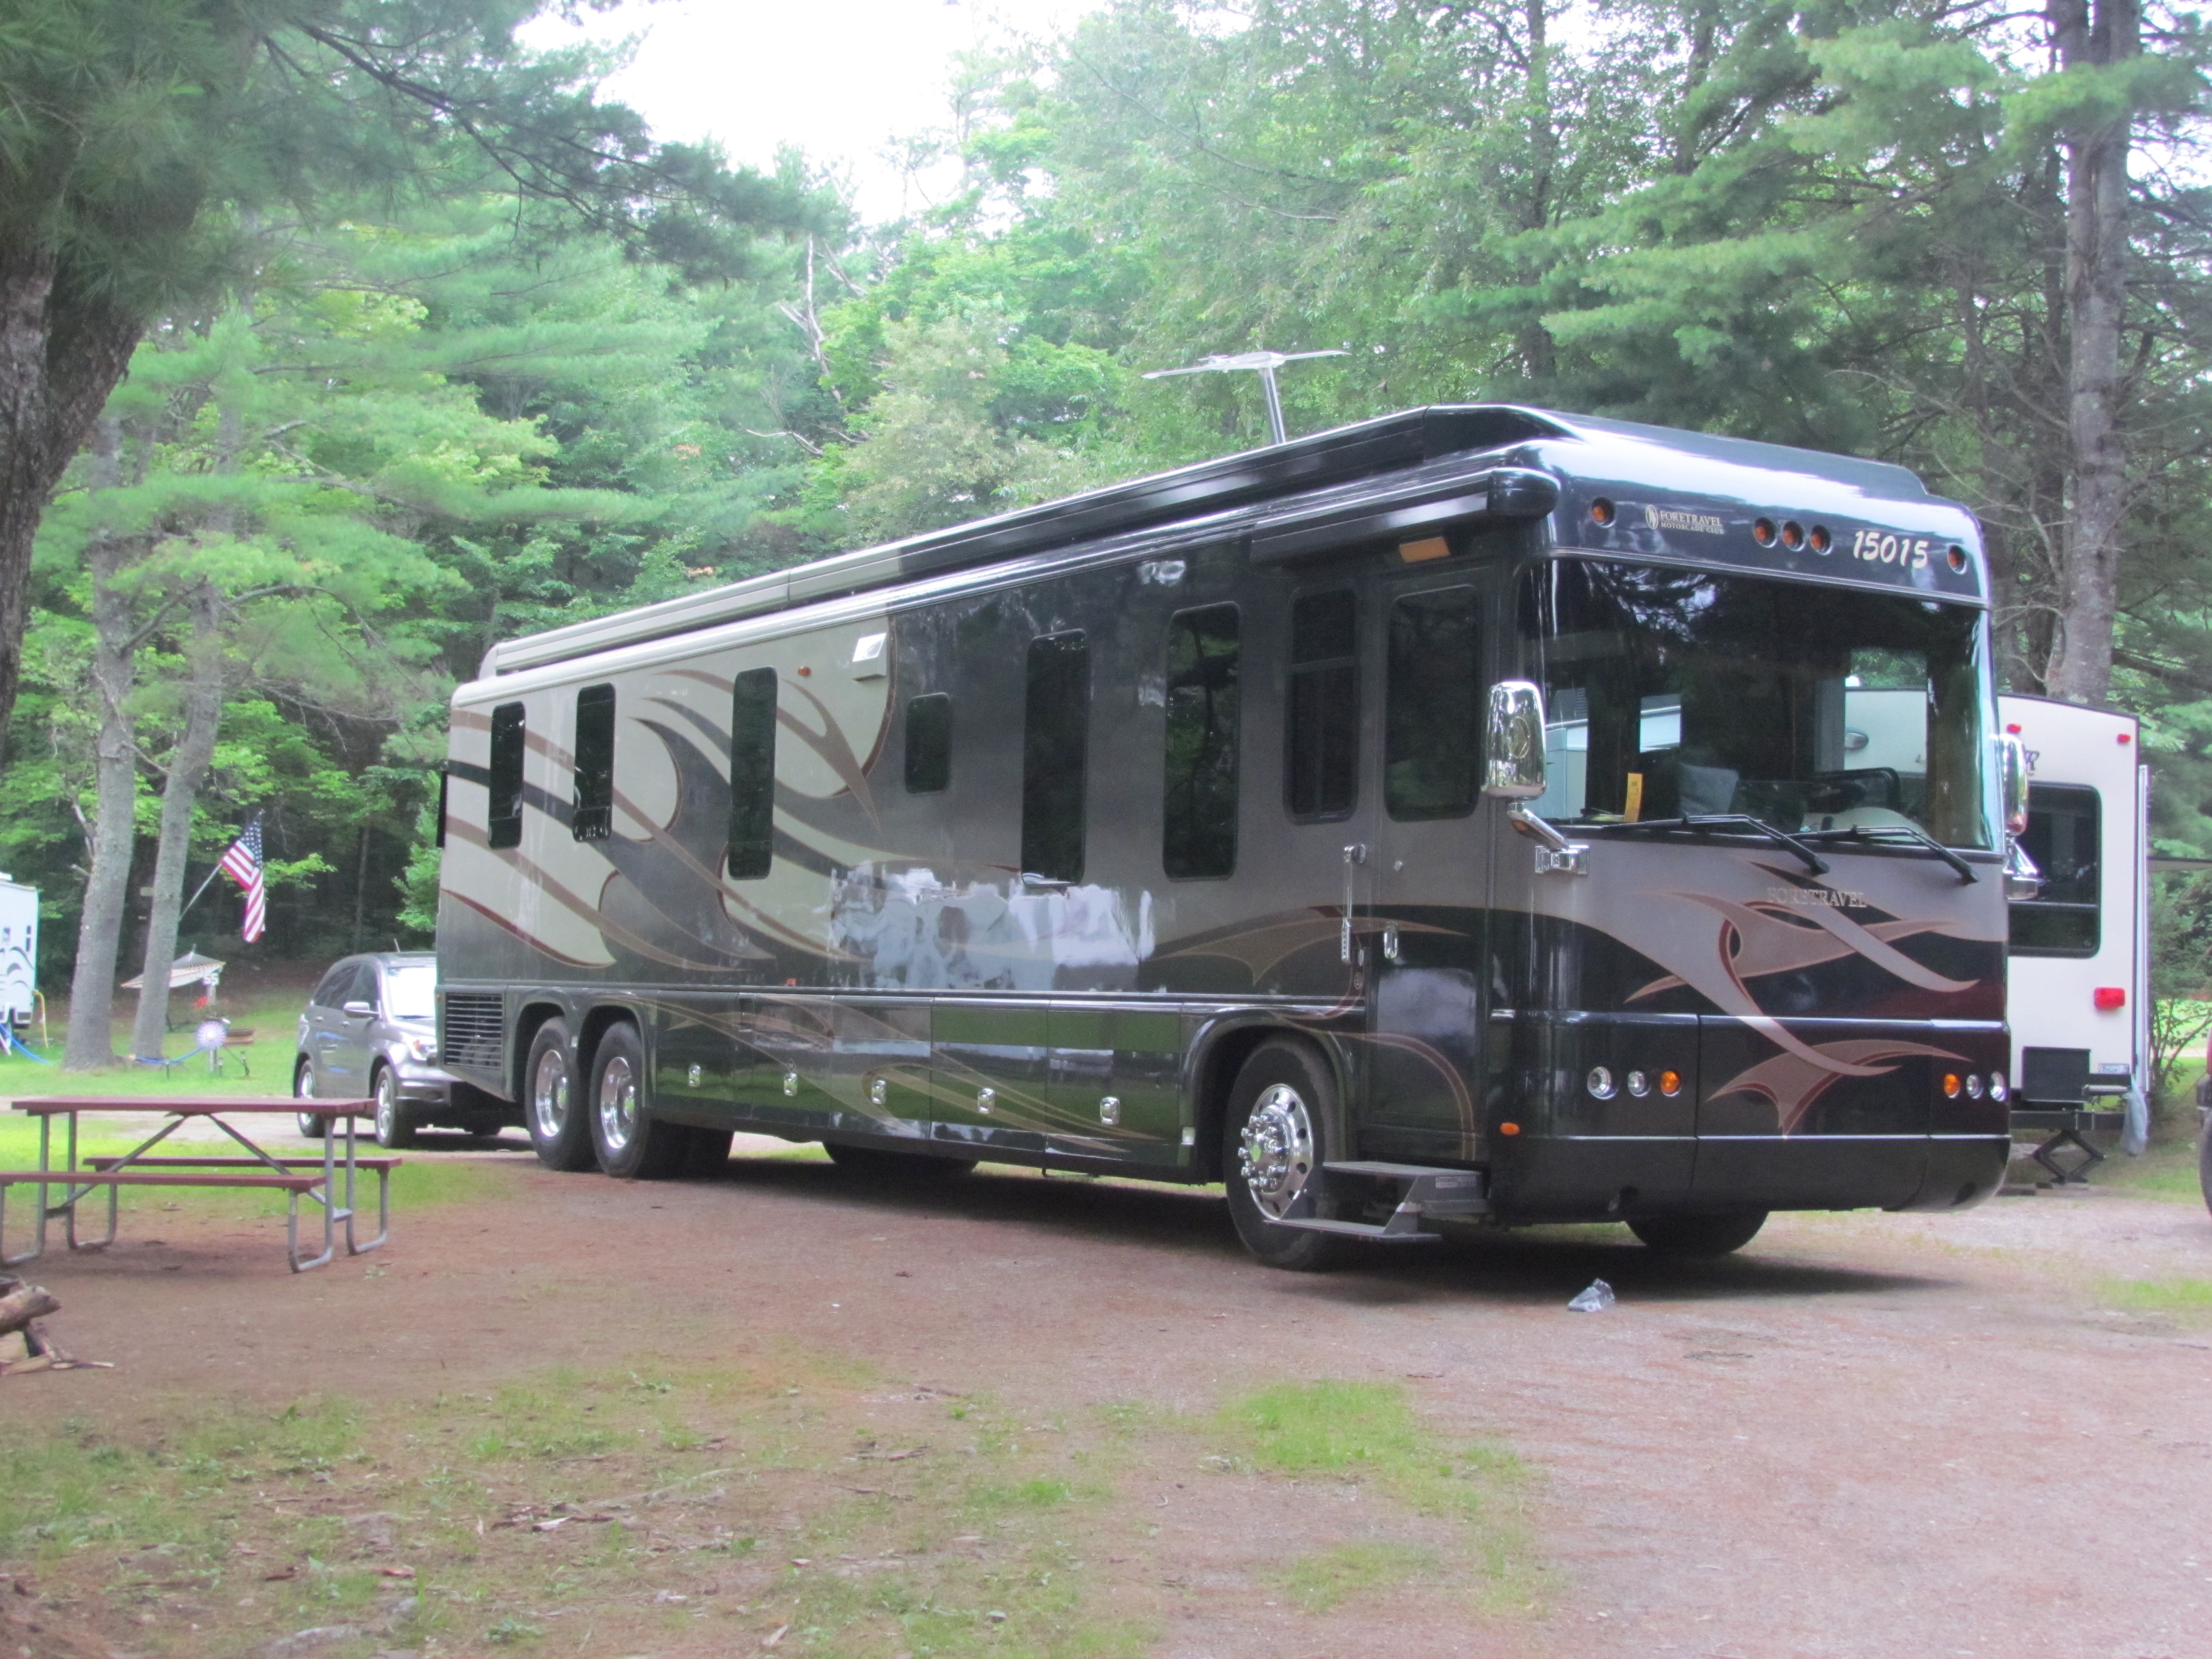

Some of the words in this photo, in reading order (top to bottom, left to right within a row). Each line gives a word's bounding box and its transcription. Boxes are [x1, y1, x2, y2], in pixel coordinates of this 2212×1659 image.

[1660, 511, 1723, 526] FORETRAVEL
[1661, 521, 1704, 532] MOTORCADE
[1706, 526, 1725, 535] CLUB
[1853, 530, 1929, 569] 15015
[1767, 887, 1867, 907] FORETRAVEL
